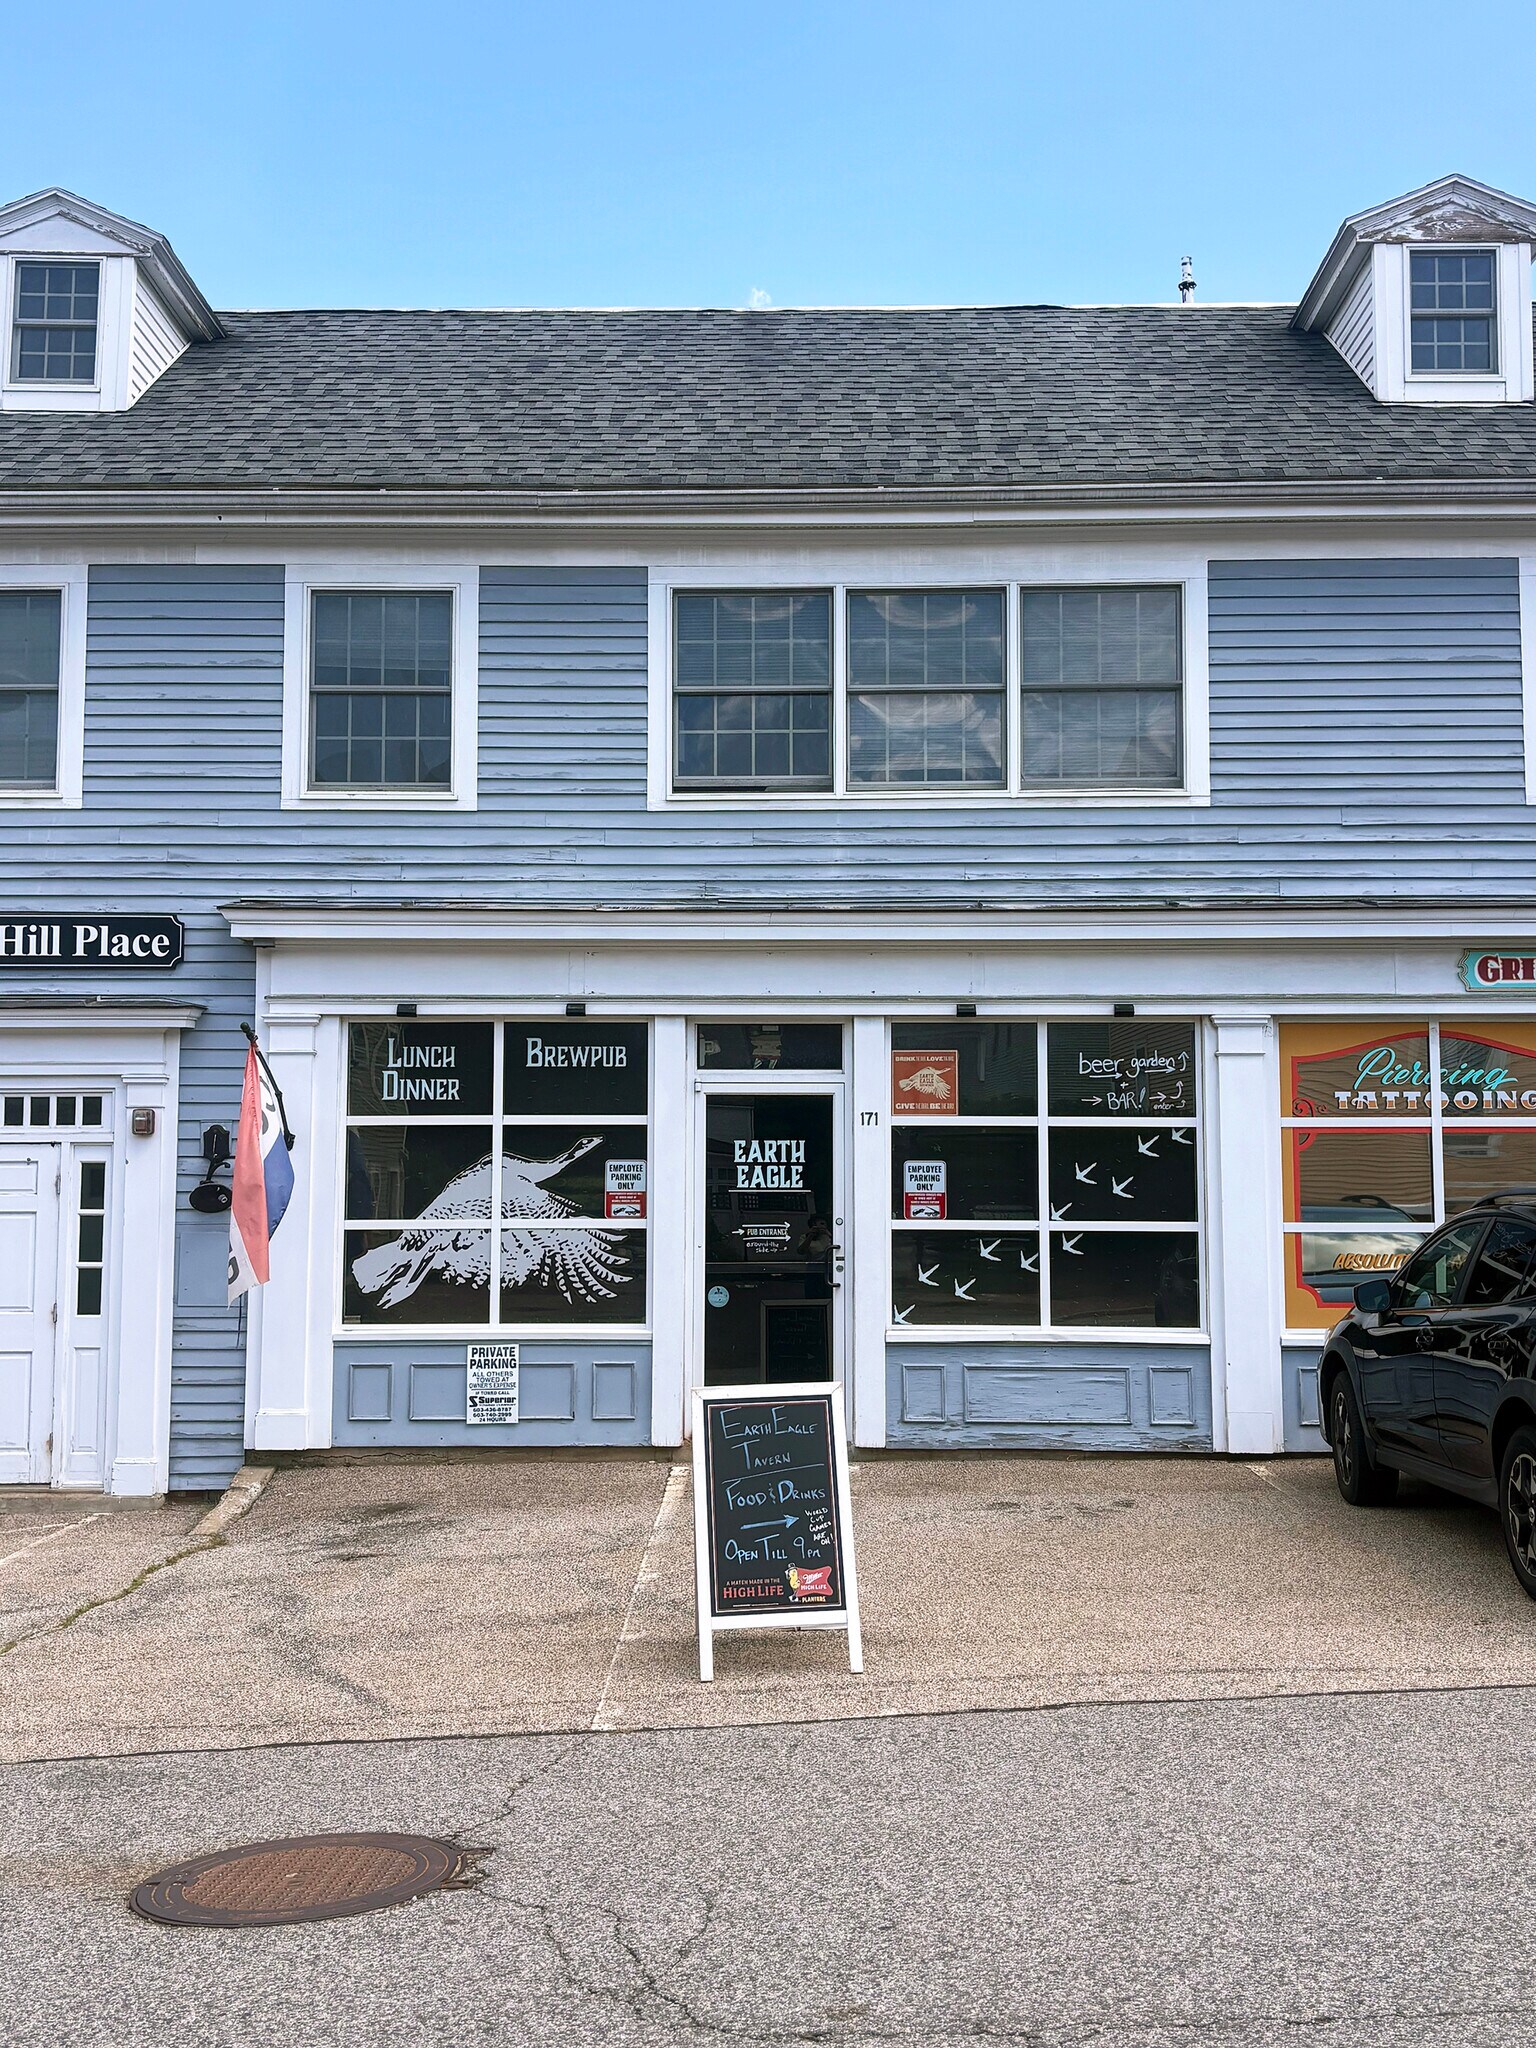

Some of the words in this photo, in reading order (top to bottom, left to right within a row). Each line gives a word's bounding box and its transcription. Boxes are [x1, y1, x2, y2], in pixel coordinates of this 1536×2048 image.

[0, 925, 62, 957] Hill
[72, 925, 170, 957] Place
[1079, 1052, 1124, 1074] beer
[1126, 1050, 1175, 1078] garden
[1107, 1087, 1146, 1110] BAR!
[860, 1111, 878, 1126] 171
[733, 1140, 806, 1163] EARTH
[609, 1164, 644, 1173] EMPLOYEE
[907, 1165, 942, 1173] EMPLOYEE
[610, 1173, 642, 1181] PARKING
[736, 1165, 804, 1188] EAGLE
[909, 1174, 941, 1182] PARKING
[617, 1182, 635, 1190] ONLY
[916, 1183, 934, 1191] ONLY
[747, 1228, 758, 1236] PUB
[471, 1346, 516, 1358] PRIVATE
[469, 1358, 517, 1369] PARKING
[720, 1407, 772, 1439] EARTH
[772, 1405, 818, 1434] EAGLE
[731, 1439, 791, 1469] TAVERN
[726, 1479, 767, 1510] FOOD
[777, 1480, 826, 1504] DRINKS
[804, 1507, 829, 1516] WORLD
[810, 1515, 825, 1523] CUP
[809, 1521, 832, 1532] GAMES
[813, 1531, 827, 1541] ARE
[802, 1572, 824, 1584] Miller
[723, 1587, 755, 1598] HIGH
[757, 1585, 784, 1596] LIFE
